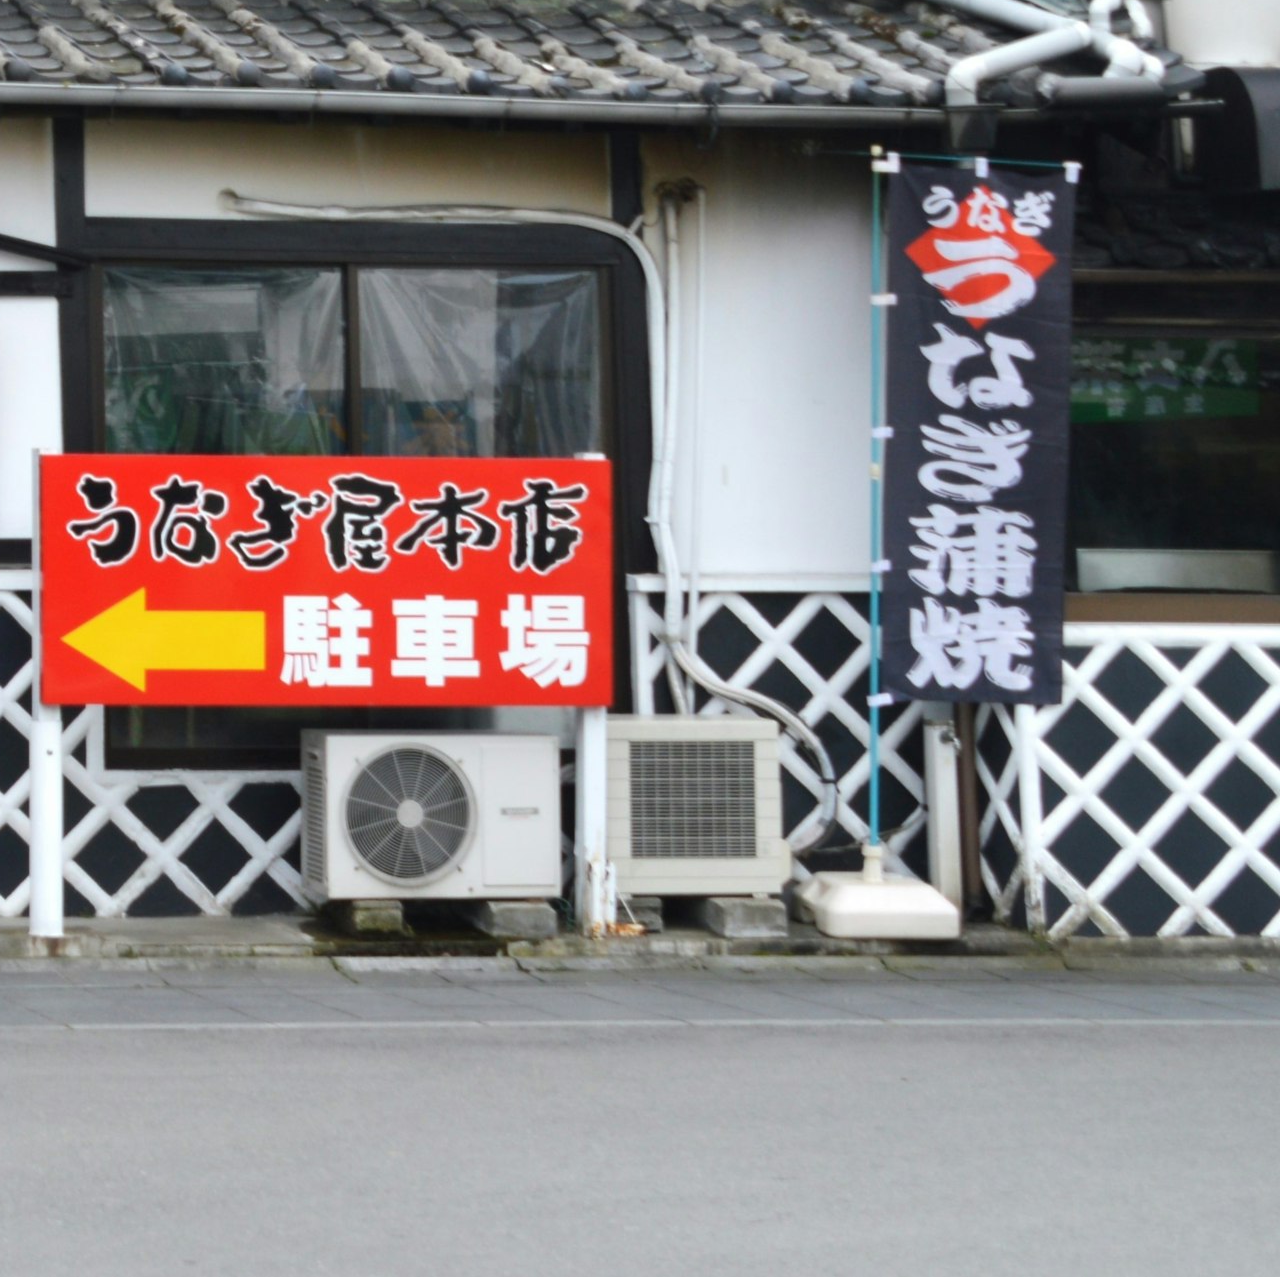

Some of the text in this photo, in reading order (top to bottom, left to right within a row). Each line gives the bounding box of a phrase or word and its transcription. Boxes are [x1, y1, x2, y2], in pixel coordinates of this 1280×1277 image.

[923, 185, 1056, 237] うなぎ
[905, 234, 1040, 692] うなぎ蒲焼
[67, 473, 589, 575] うなぎ屋本店
[280, 592, 590, 689] 駐車場
